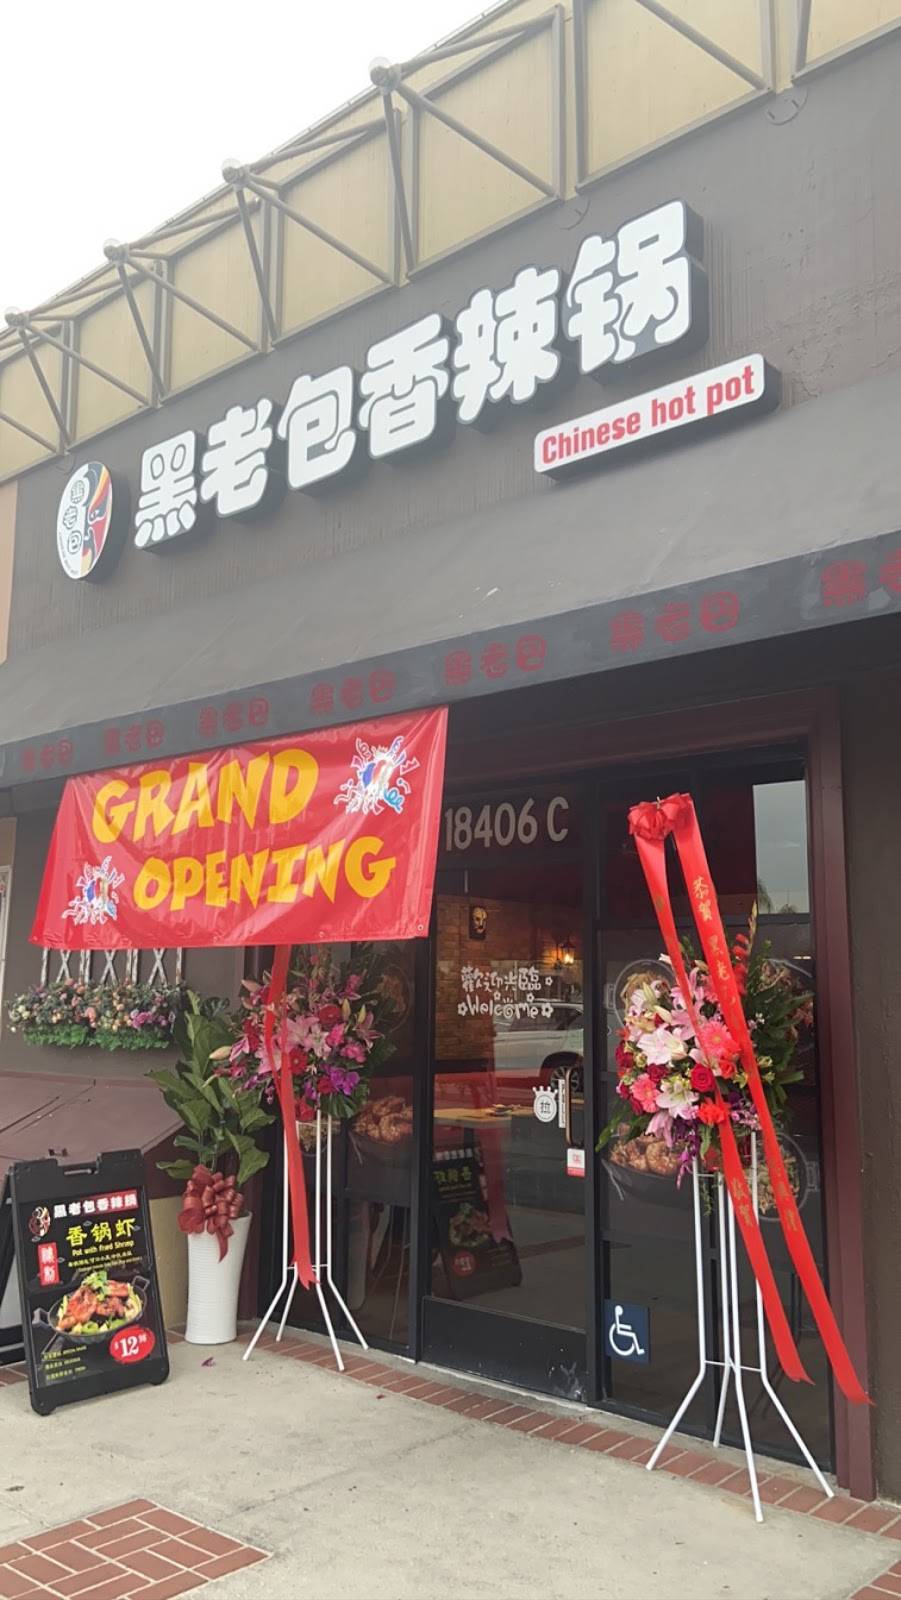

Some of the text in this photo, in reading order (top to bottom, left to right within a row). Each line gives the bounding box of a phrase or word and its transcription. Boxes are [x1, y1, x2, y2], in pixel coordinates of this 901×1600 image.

[135, 200, 692, 549] 黑老包香辣锅
[543, 365, 755, 464] Chinese hot pot
[92, 748, 319, 844] GRAND
[445, 796, 569, 851] 18406 C
[133, 836, 396, 912] OPENING
[466, 994, 539, 1020] Welcome
[66, 1218, 136, 1247] 香锅虾
[84, 1245, 98, 1254] with
